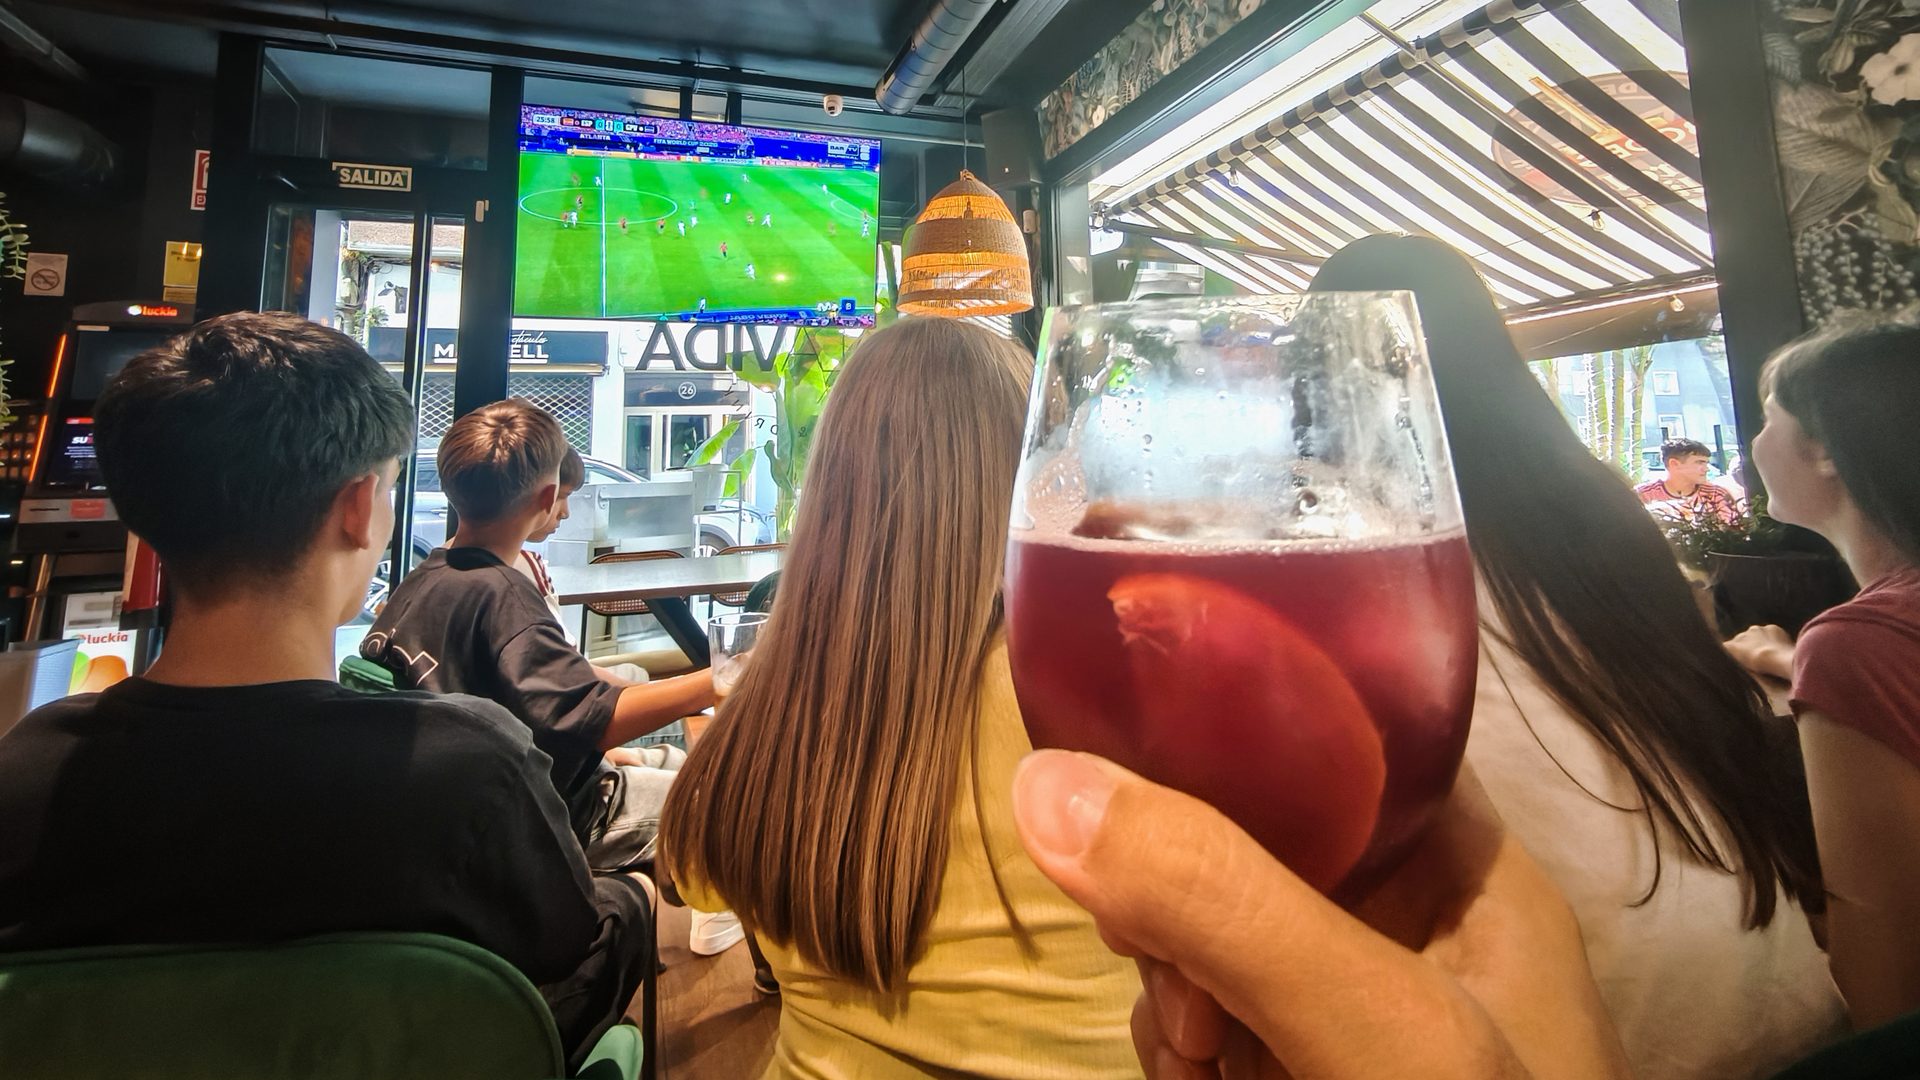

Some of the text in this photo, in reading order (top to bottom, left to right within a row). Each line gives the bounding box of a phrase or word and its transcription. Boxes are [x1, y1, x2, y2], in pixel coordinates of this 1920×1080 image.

[536, 115, 556, 124] 25:58
[579, 133, 611, 141] ATLANTA
[339, 167, 404, 187] SALIDA
[142, 305, 178, 317] luckia
[86, 631, 129, 645] luckia
